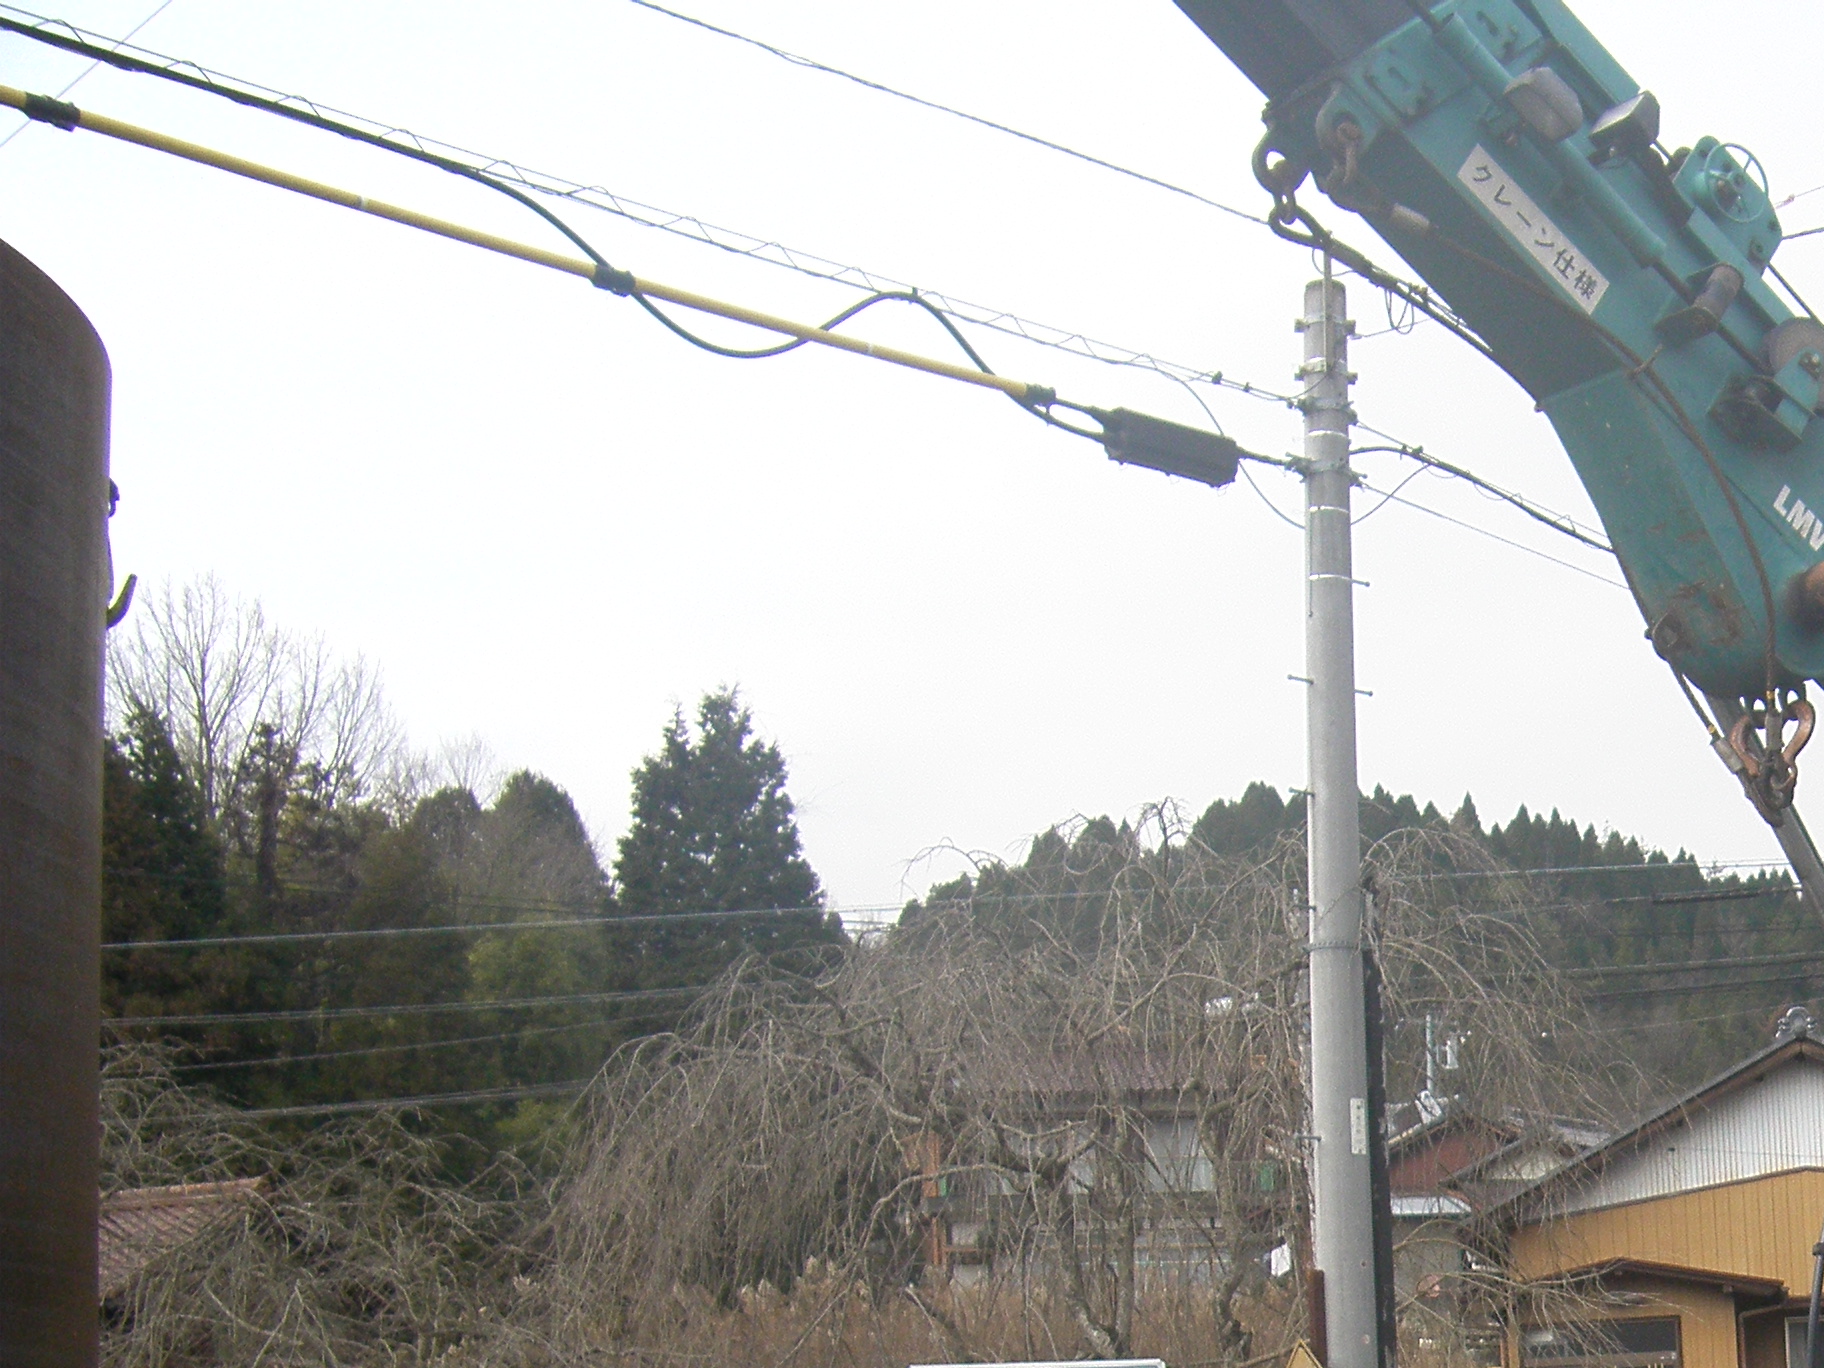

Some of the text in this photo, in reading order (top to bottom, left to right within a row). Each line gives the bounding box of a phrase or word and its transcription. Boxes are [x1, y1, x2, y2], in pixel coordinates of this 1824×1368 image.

[1472, 164, 1598, 302] クレーン仕様
